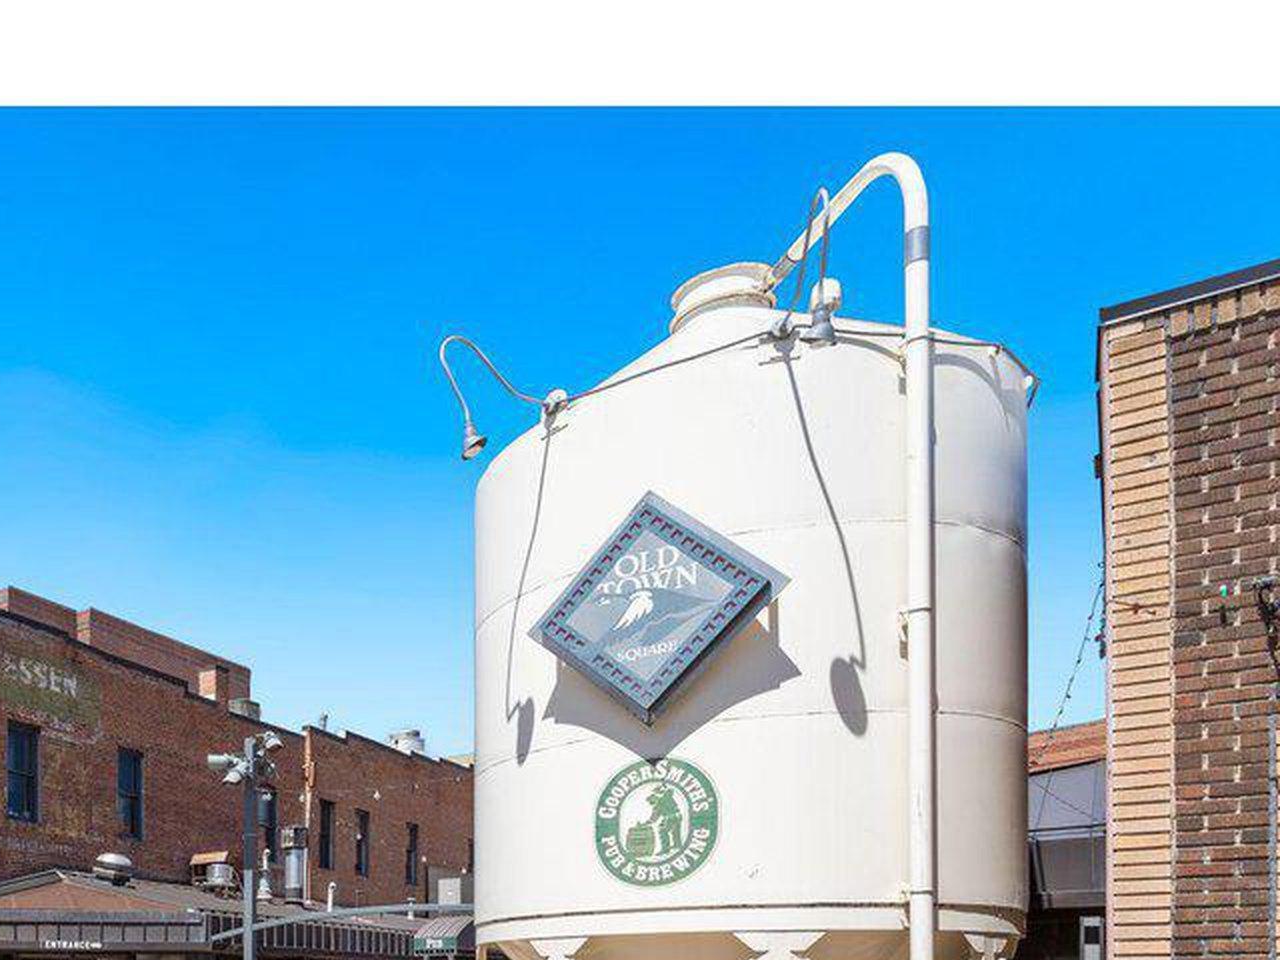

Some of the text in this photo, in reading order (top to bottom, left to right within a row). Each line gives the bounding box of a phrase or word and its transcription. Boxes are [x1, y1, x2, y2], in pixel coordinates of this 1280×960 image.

[614, 547, 680, 577] OLD
[595, 562, 698, 594] TOWN
[45, 939, 91, 950] ENTRANCE
